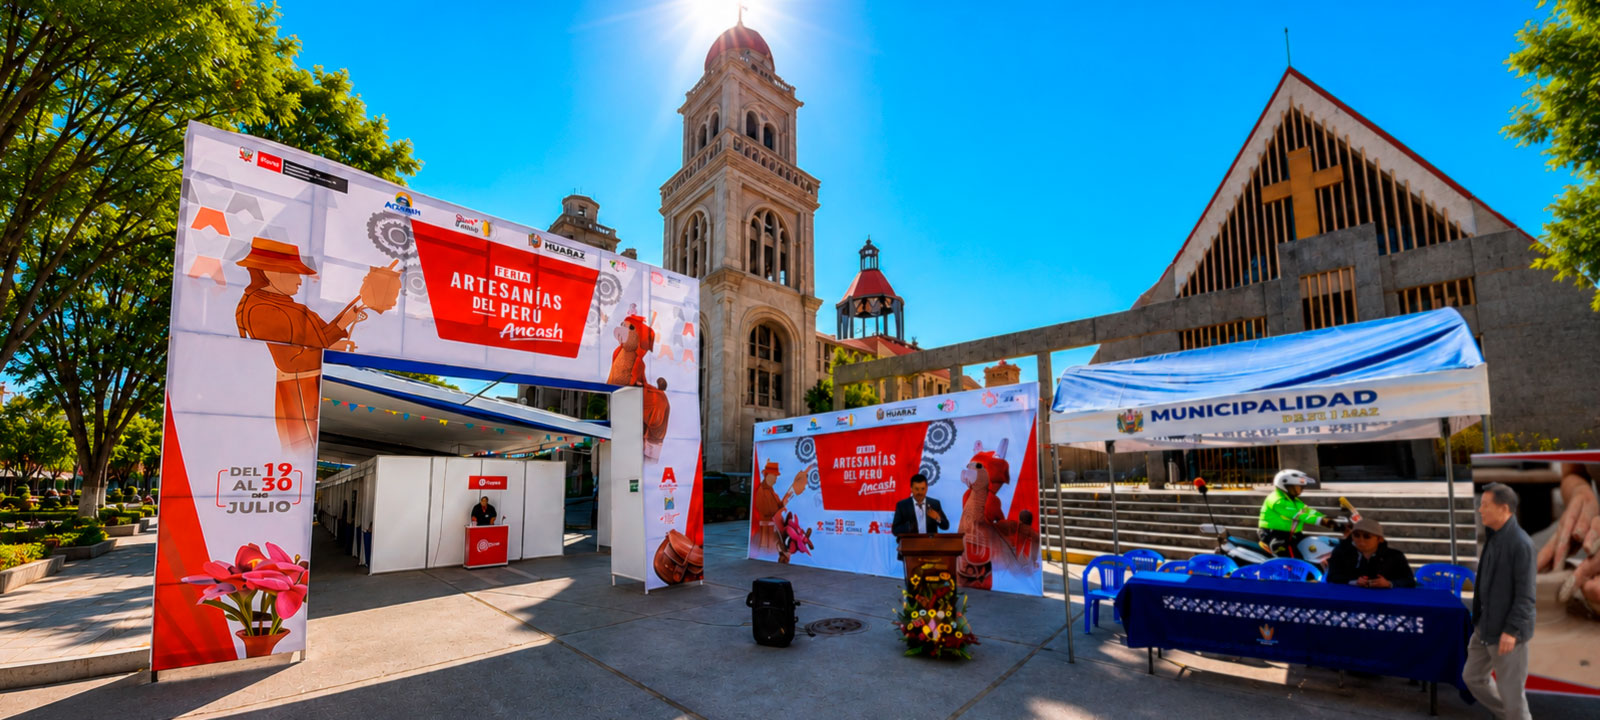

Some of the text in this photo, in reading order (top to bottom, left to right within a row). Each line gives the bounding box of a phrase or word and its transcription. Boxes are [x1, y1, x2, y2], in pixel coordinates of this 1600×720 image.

[497, 267, 529, 282] FERIA
[451, 271, 562, 310] ARTESANÍAS
[473, 296, 541, 324] DEL PERÚ
[499, 322, 563, 340] Ancash
[1151, 390, 1378, 422] MUNICIPALIDAD
[833, 451, 896, 469] ARTESANÍAS
[230, 462, 293, 477] DEL 19
[844, 470, 857, 480] DEL
[232, 477, 293, 491] AL 30
[858, 475, 896, 496] Ancash
[226, 500, 291, 514] JULIO
